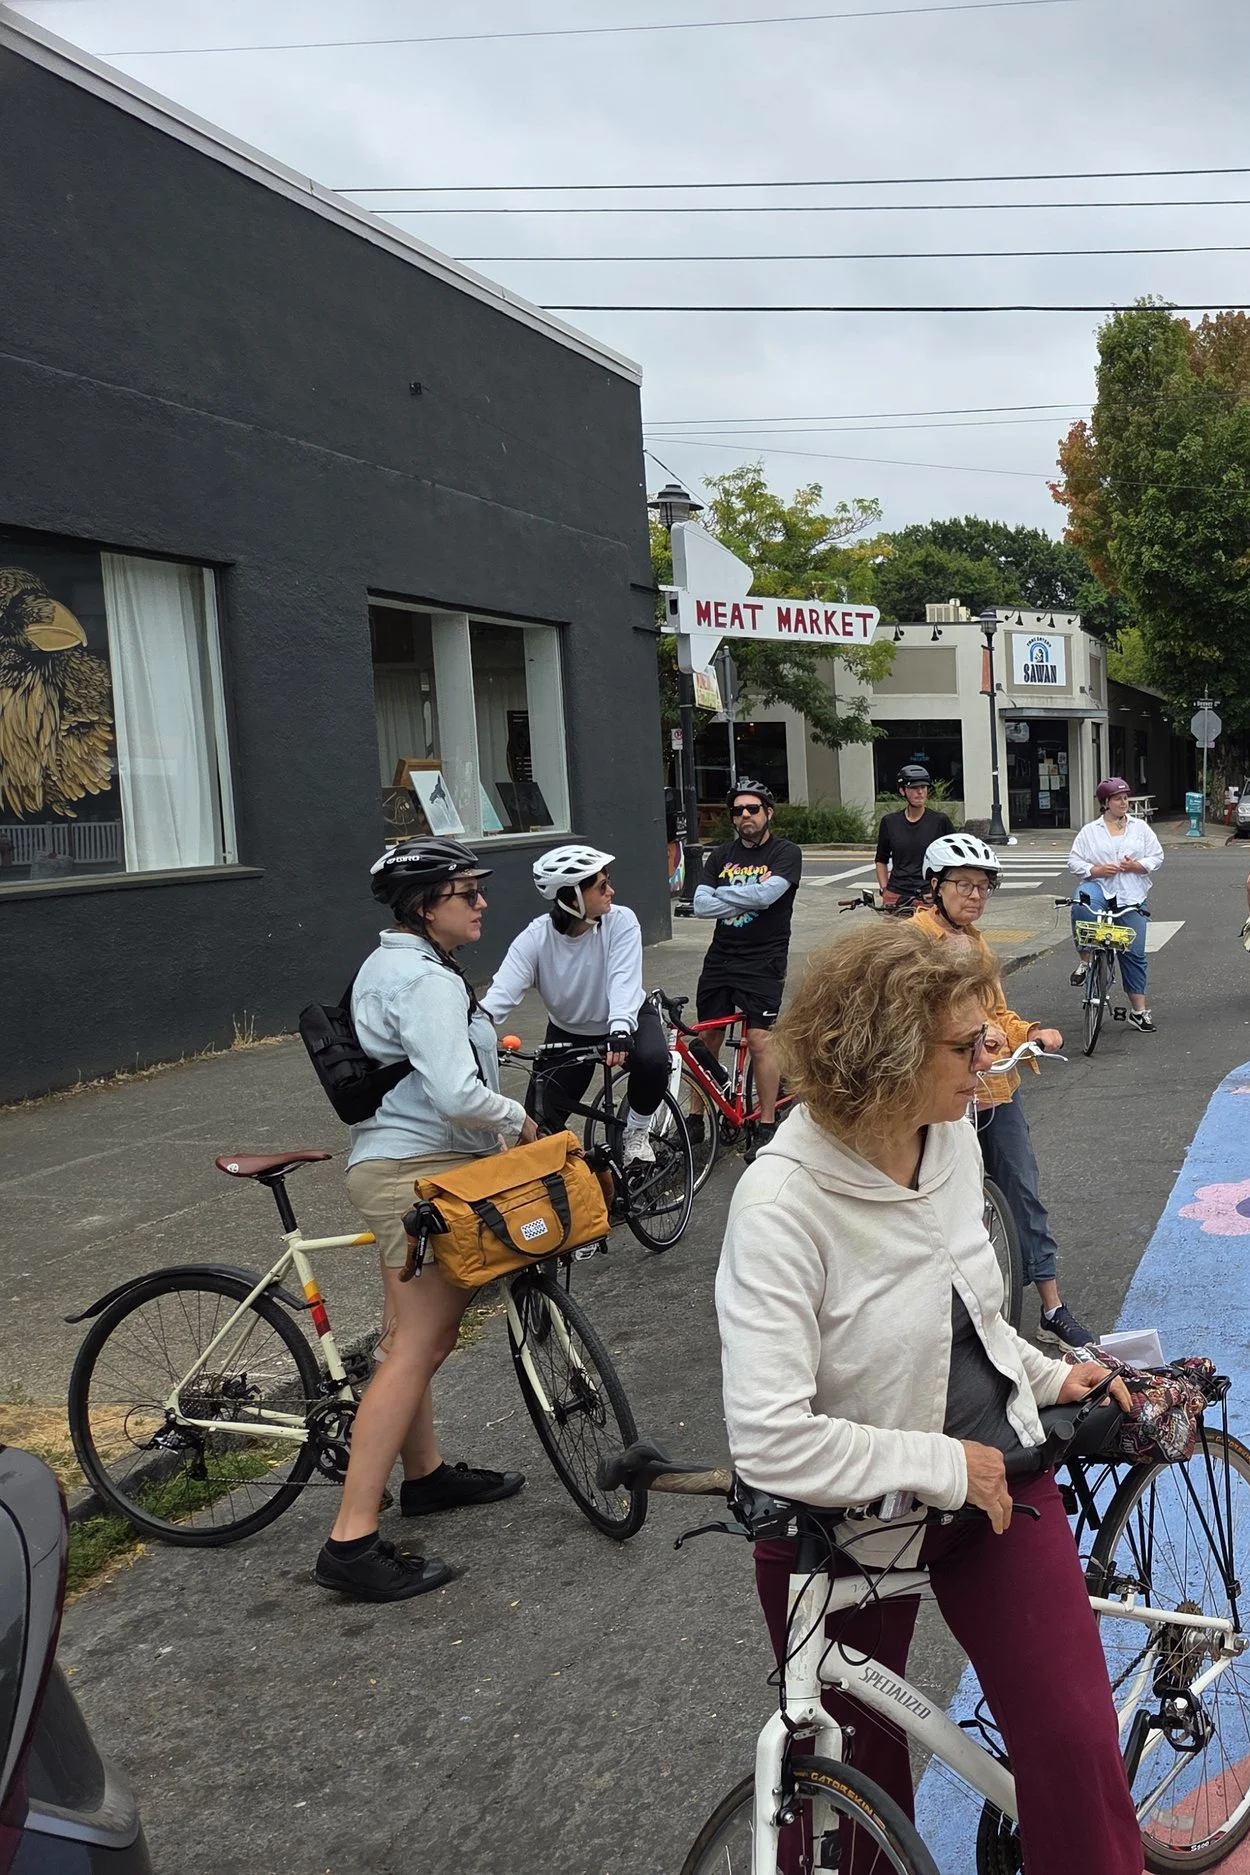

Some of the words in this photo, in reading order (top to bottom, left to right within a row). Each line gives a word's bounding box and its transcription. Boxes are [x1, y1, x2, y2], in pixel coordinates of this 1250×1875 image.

[695, 600, 764, 630] MEAT
[777, 606, 874, 637] MARKET
[1023, 663, 1057, 684] SAWAN
[858, 1666, 932, 1720] SPECIALIZED
[810, 1771, 874, 1816] GATORSKIN
